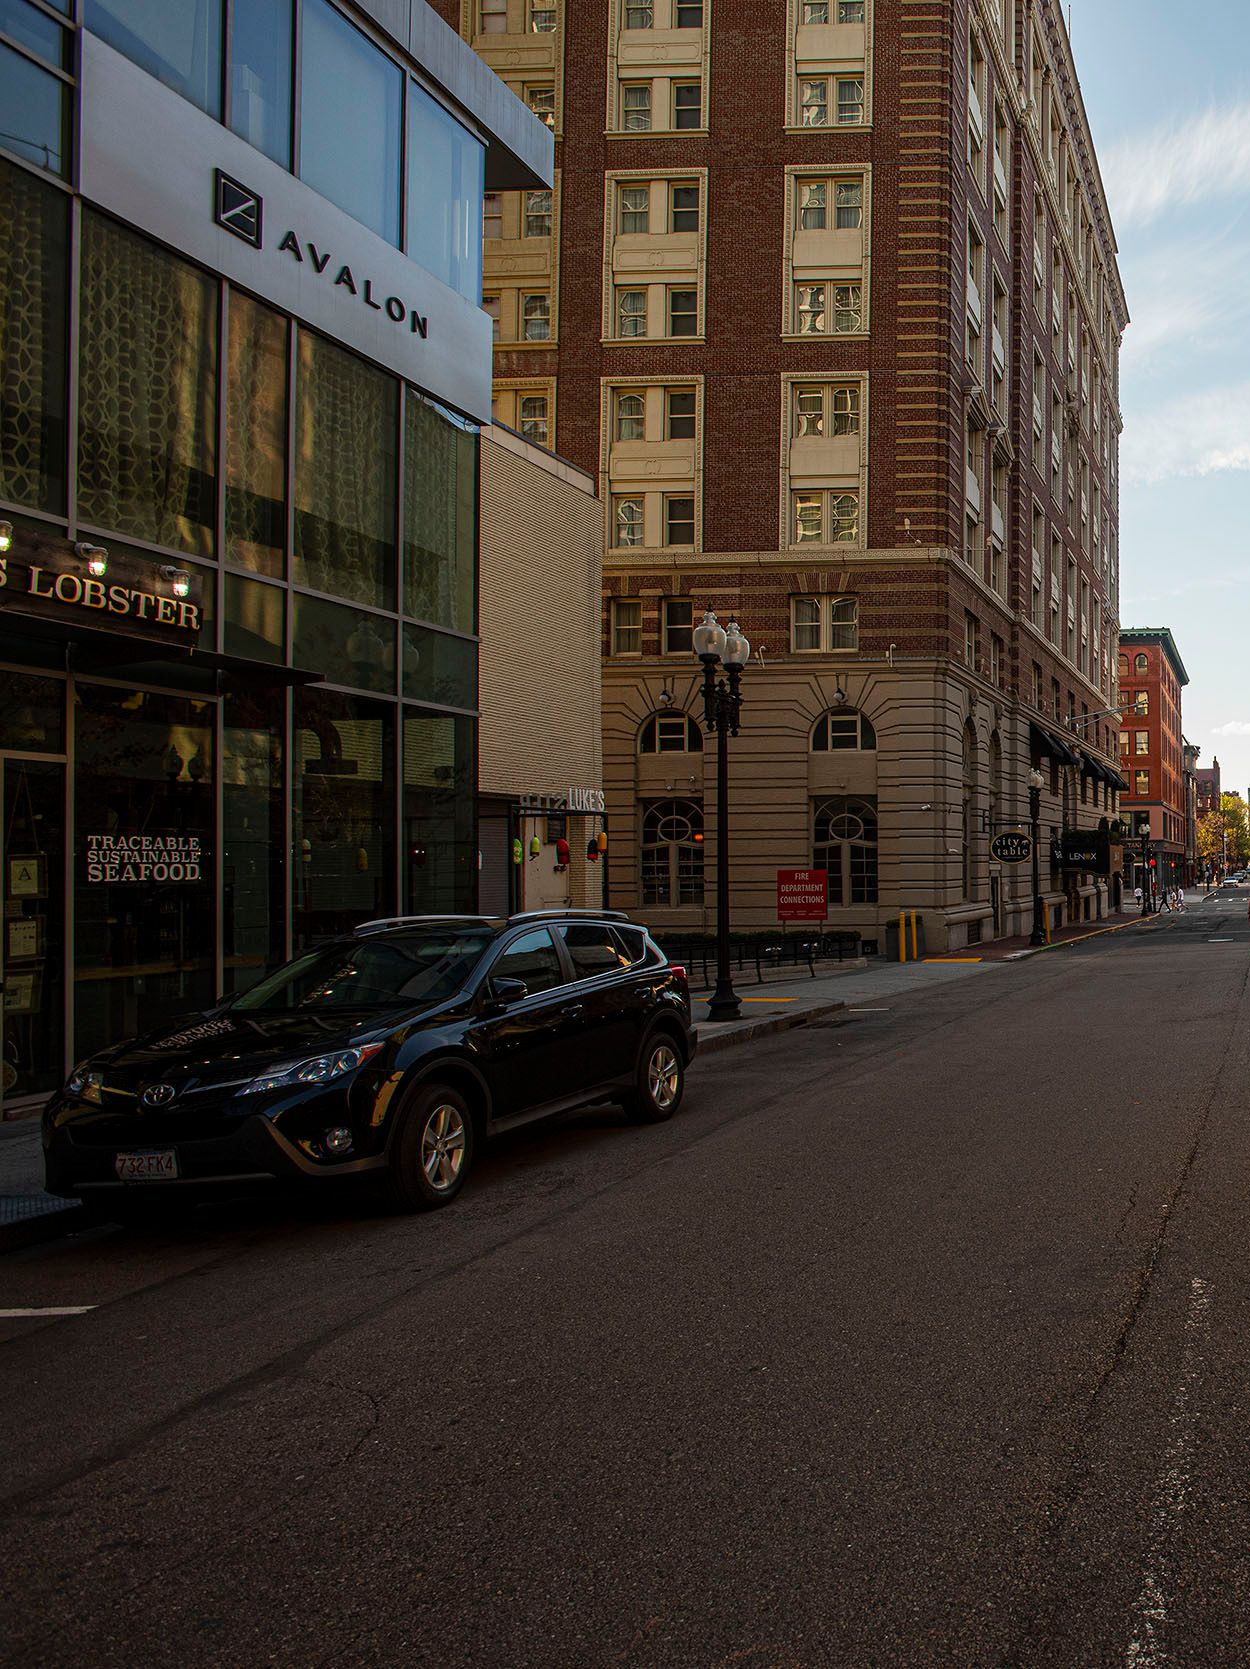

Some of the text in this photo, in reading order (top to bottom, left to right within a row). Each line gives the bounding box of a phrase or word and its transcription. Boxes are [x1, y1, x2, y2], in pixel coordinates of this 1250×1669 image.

[279, 230, 429, 340] AVALON
[28, 565, 200, 630] LOBSTER
[569, 787, 605, 811] LUKE'S
[995, 837, 1021, 847] city
[997, 847, 1028, 856] table
[87, 851, 200, 863] SUSTAINABLE
[794, 872, 809, 880] FIRE
[781, 884, 823, 892] DEPARTMENT
[780, 895, 825, 904] CONNECTIONS
